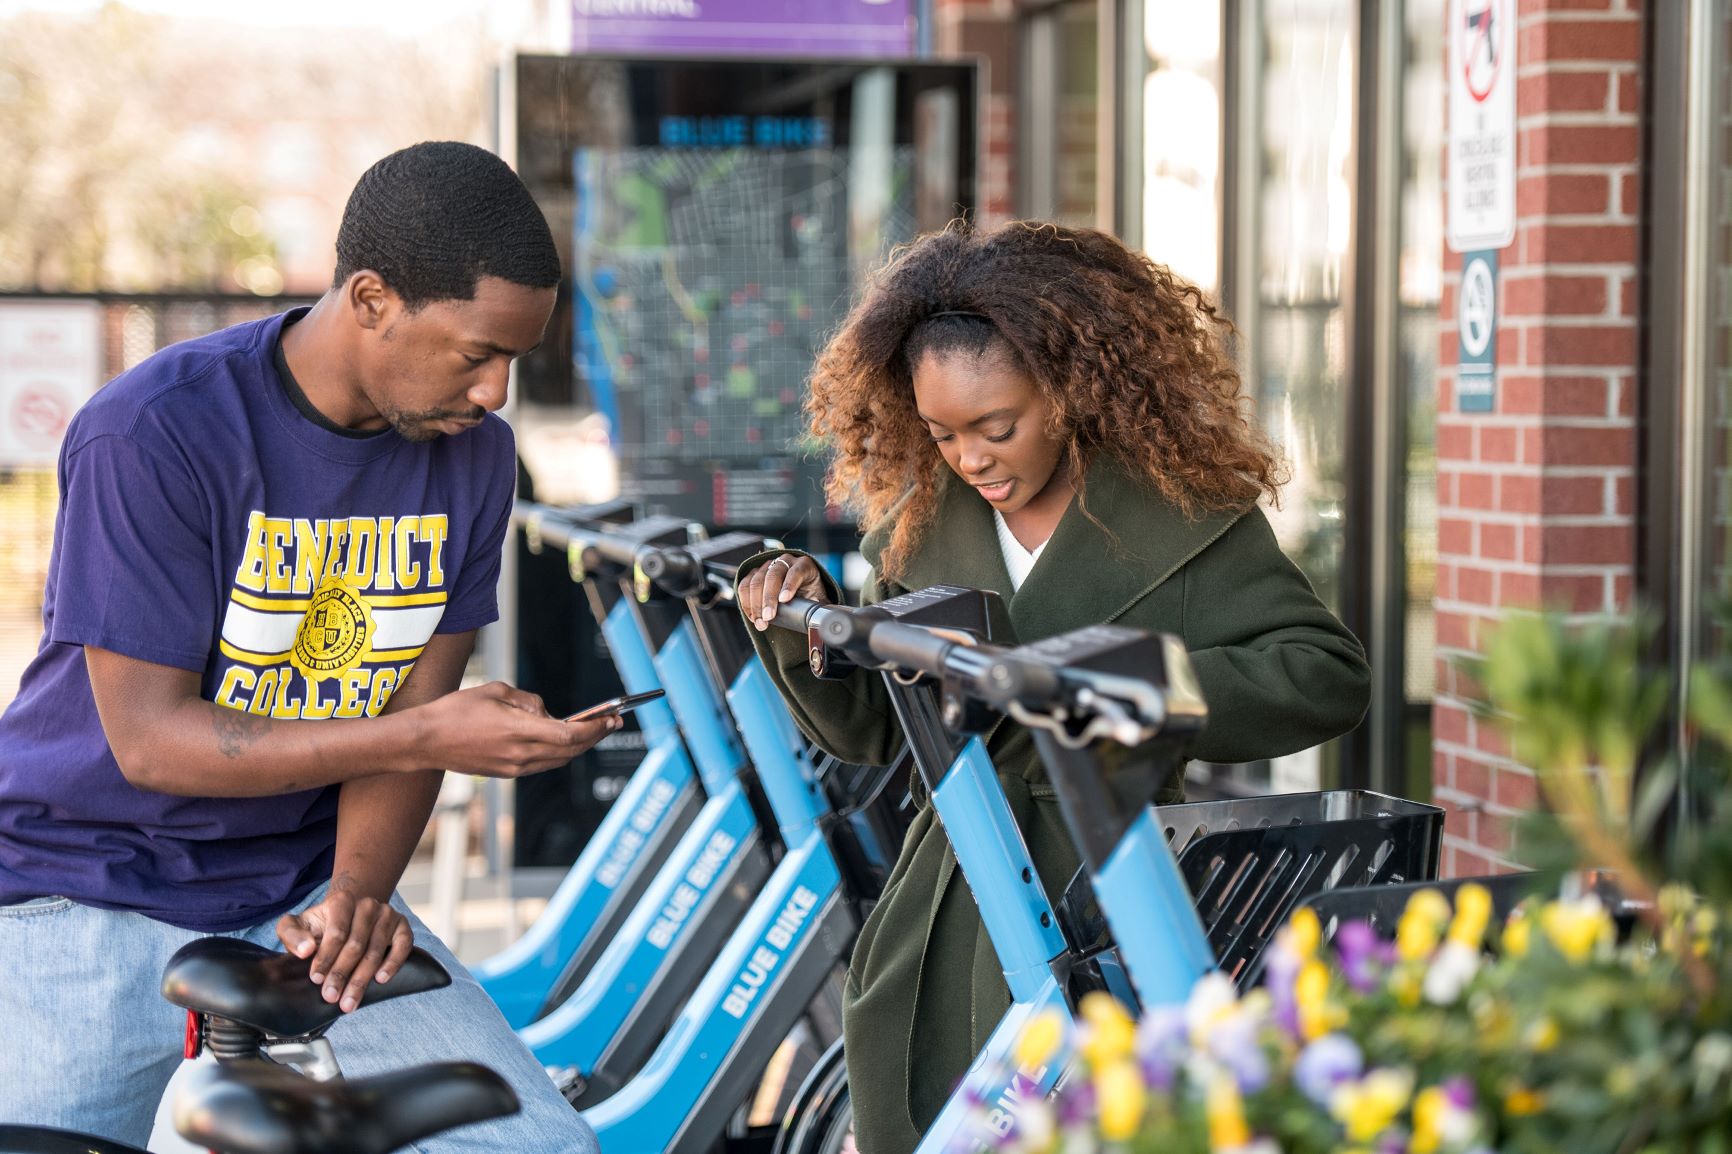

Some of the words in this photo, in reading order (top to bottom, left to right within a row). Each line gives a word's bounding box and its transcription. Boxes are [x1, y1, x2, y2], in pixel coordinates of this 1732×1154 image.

[660, 116, 745, 145] BLUE
[753, 116, 829, 146] BIKE
[235, 510, 448, 593] BENEDICT
[326, 631, 337, 644] U
[595, 828, 644, 889] BLUE
[630, 778, 676, 833] BIKE
[646, 881, 700, 950] BLUE
[686, 829, 736, 889] BIKE
[721, 945, 780, 1019] BLUE
[765, 885, 819, 951] BIKE
